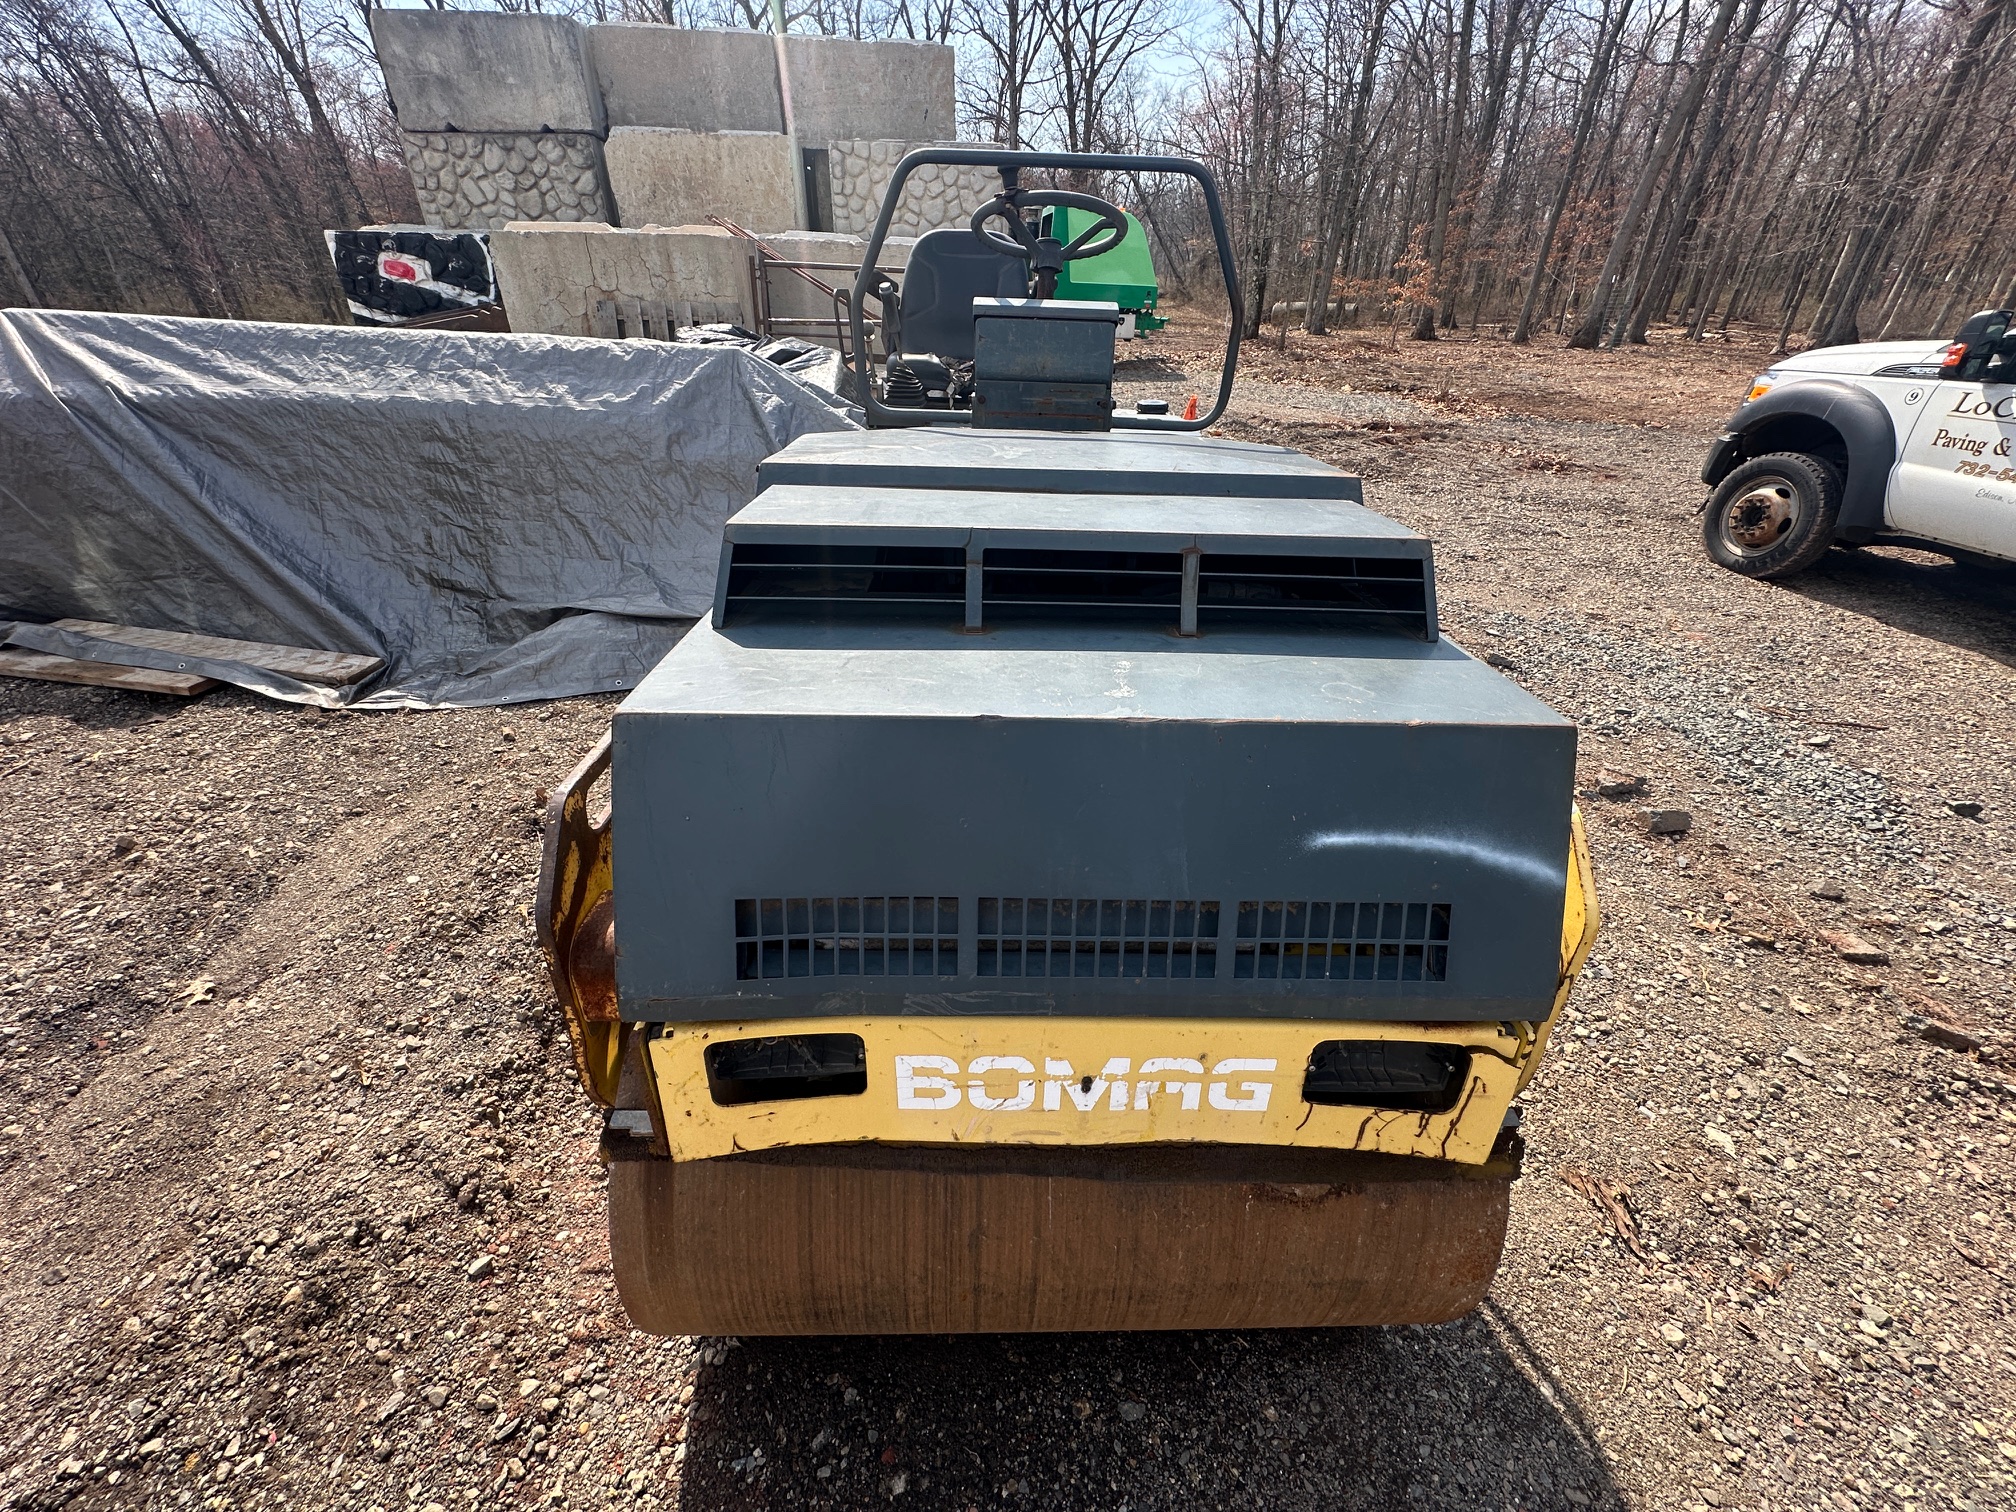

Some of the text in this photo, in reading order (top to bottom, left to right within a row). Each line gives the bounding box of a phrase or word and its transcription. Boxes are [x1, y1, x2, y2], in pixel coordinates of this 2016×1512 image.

[1908, 391, 1919, 402] 9
[1951, 391, 2016, 419] LoC
[1931, 428, 2012, 457] Paving &
[894, 1054, 1278, 1112] BOMAG
